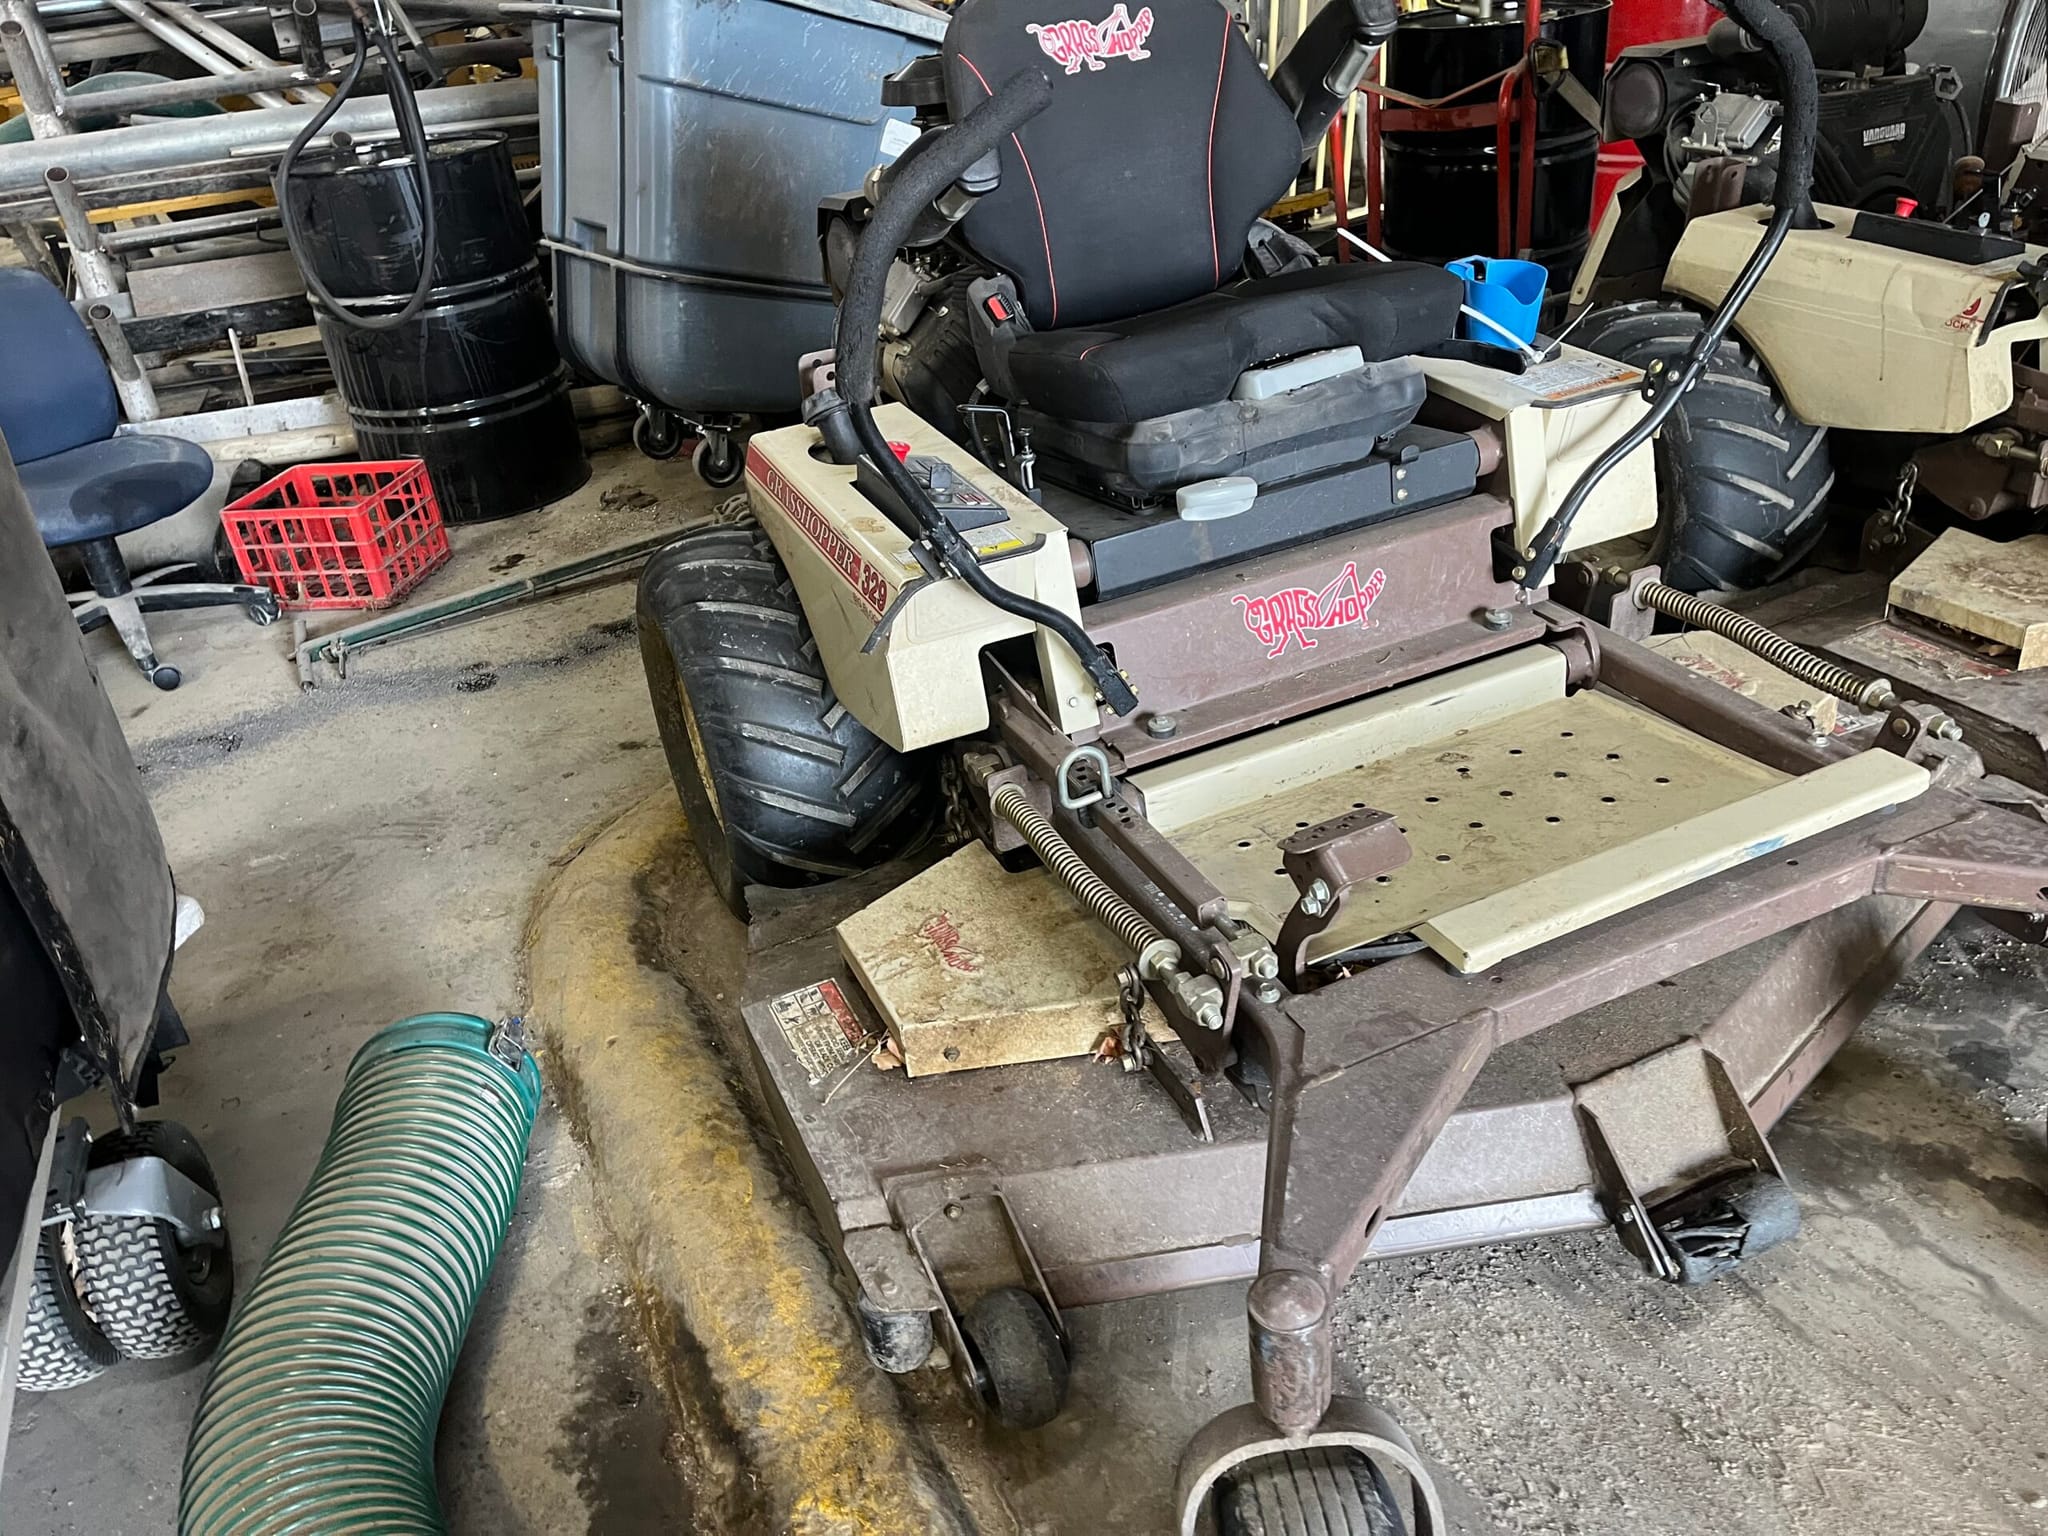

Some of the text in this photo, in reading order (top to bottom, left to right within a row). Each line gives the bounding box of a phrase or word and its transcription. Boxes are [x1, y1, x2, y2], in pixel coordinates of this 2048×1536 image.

[1863, 123, 1906, 143] VANGUARD
[766, 469, 854, 576] GRASSHOPPER
[861, 564, 887, 612] 329
